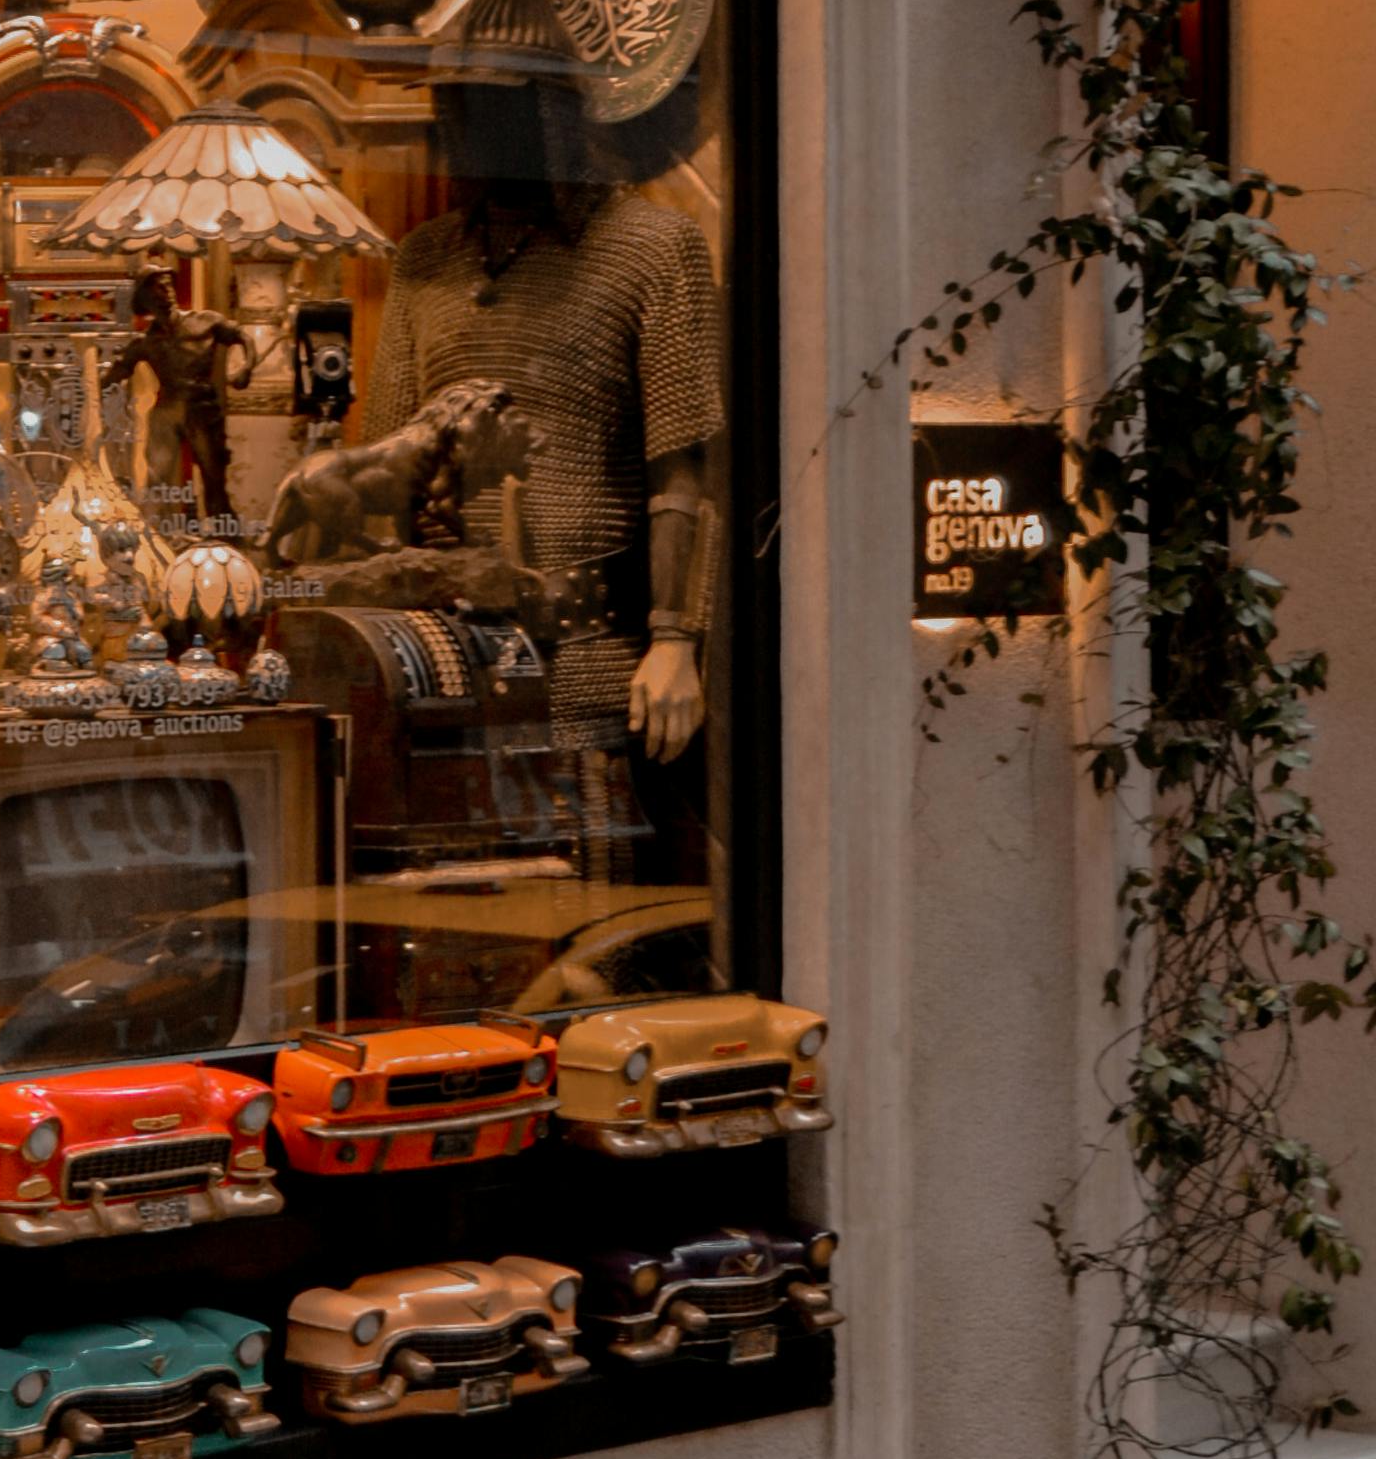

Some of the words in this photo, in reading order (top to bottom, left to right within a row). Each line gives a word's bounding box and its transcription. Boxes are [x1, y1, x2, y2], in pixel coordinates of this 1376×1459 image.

[926, 478, 1003, 513] casa
[925, 514, 1044, 564] genova
[261, 575, 327, 599] Galata
[4, 722, 39, 744] IG:
[43, 713, 244, 747] @genova_auctions
